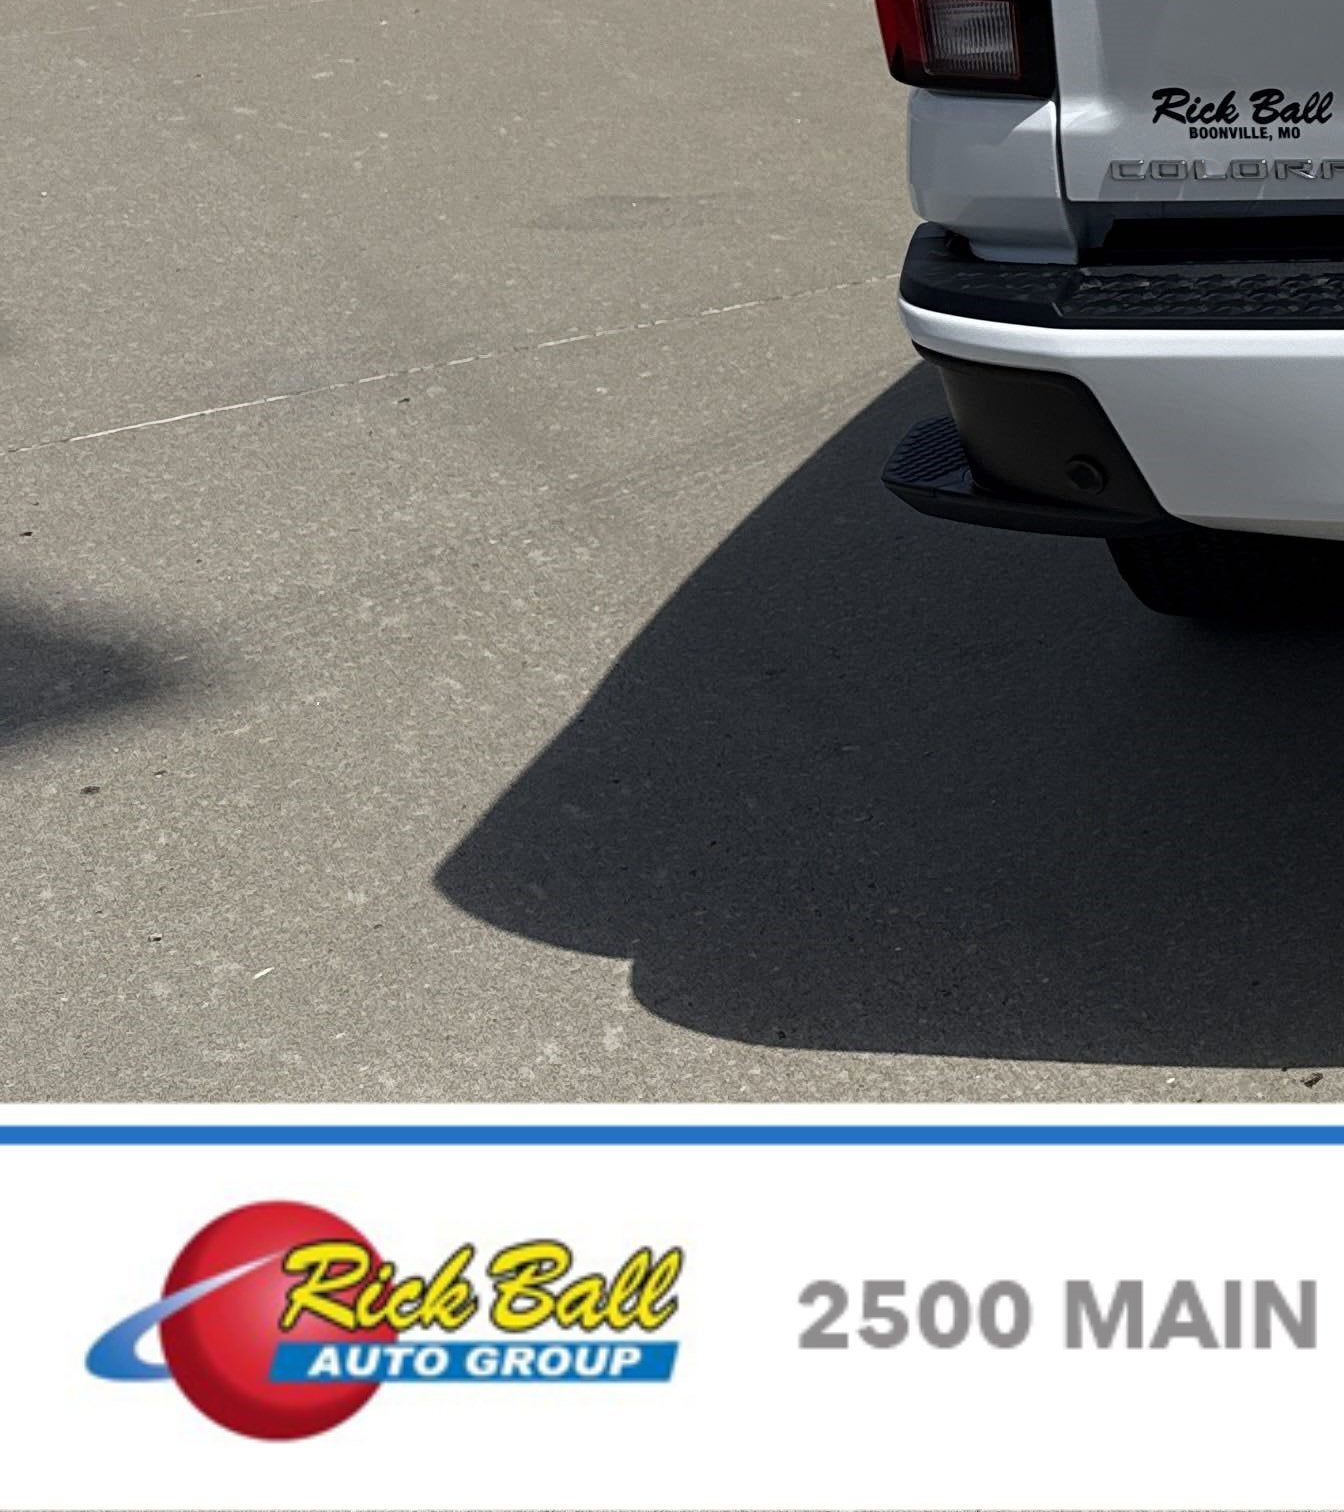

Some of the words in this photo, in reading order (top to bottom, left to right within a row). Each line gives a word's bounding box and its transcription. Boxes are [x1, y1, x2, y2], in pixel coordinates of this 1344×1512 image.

[1151, 87, 1239, 125] Rick
[1249, 87, 1334, 125] Ball
[1189, 126, 1273, 142] BOONVILLE,
[1277, 126, 1301, 140] MO
